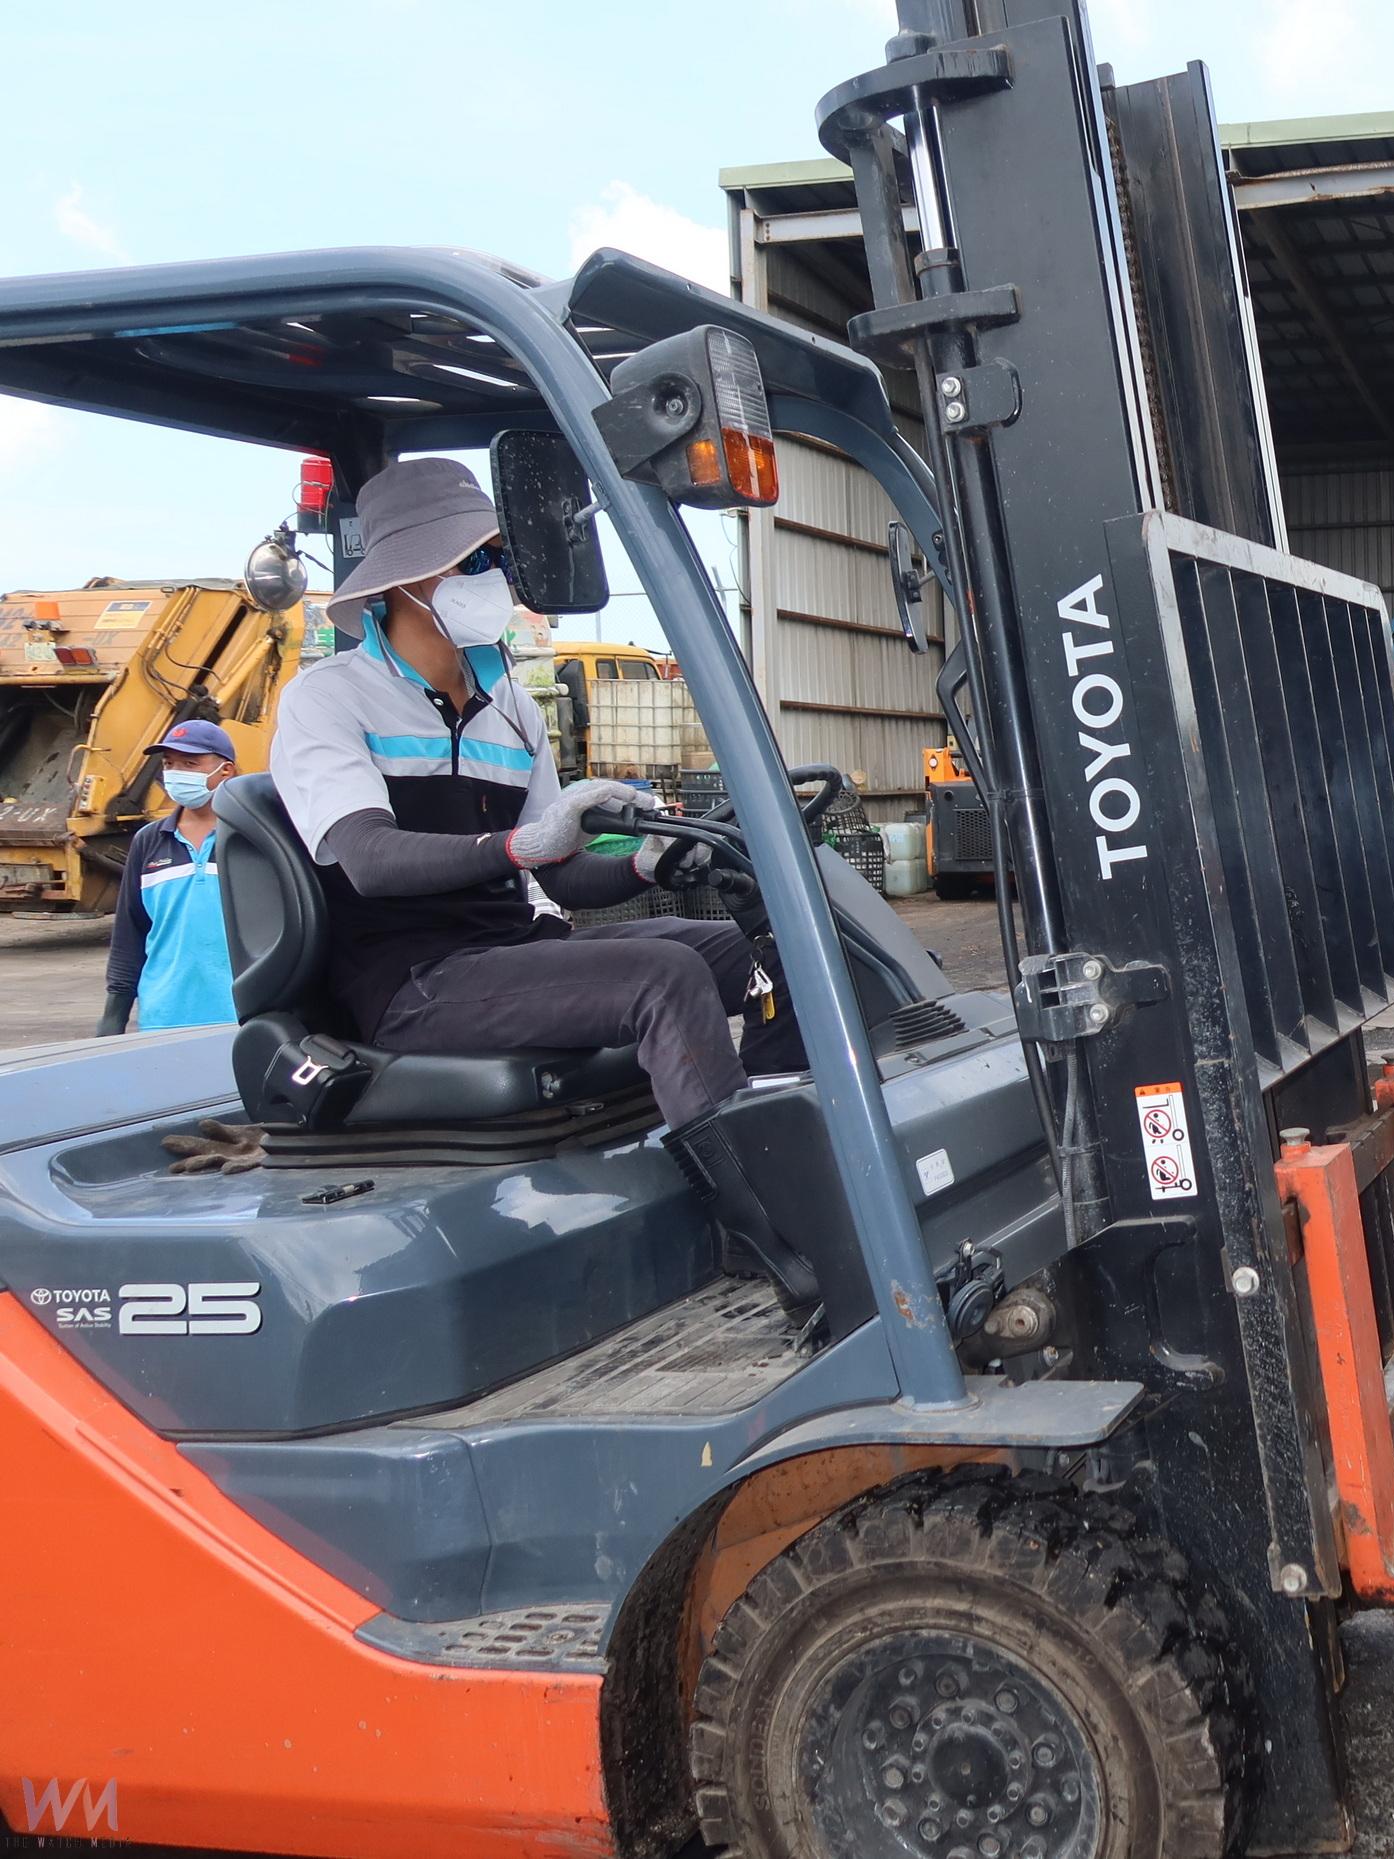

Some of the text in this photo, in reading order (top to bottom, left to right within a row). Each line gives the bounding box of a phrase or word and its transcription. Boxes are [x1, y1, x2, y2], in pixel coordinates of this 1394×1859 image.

[1057, 574, 1148, 880] TOYOTA
[53, 1289, 111, 1303] TOYOTA
[118, 1282, 262, 1335] 25
[56, 1307, 112, 1321] SAS
